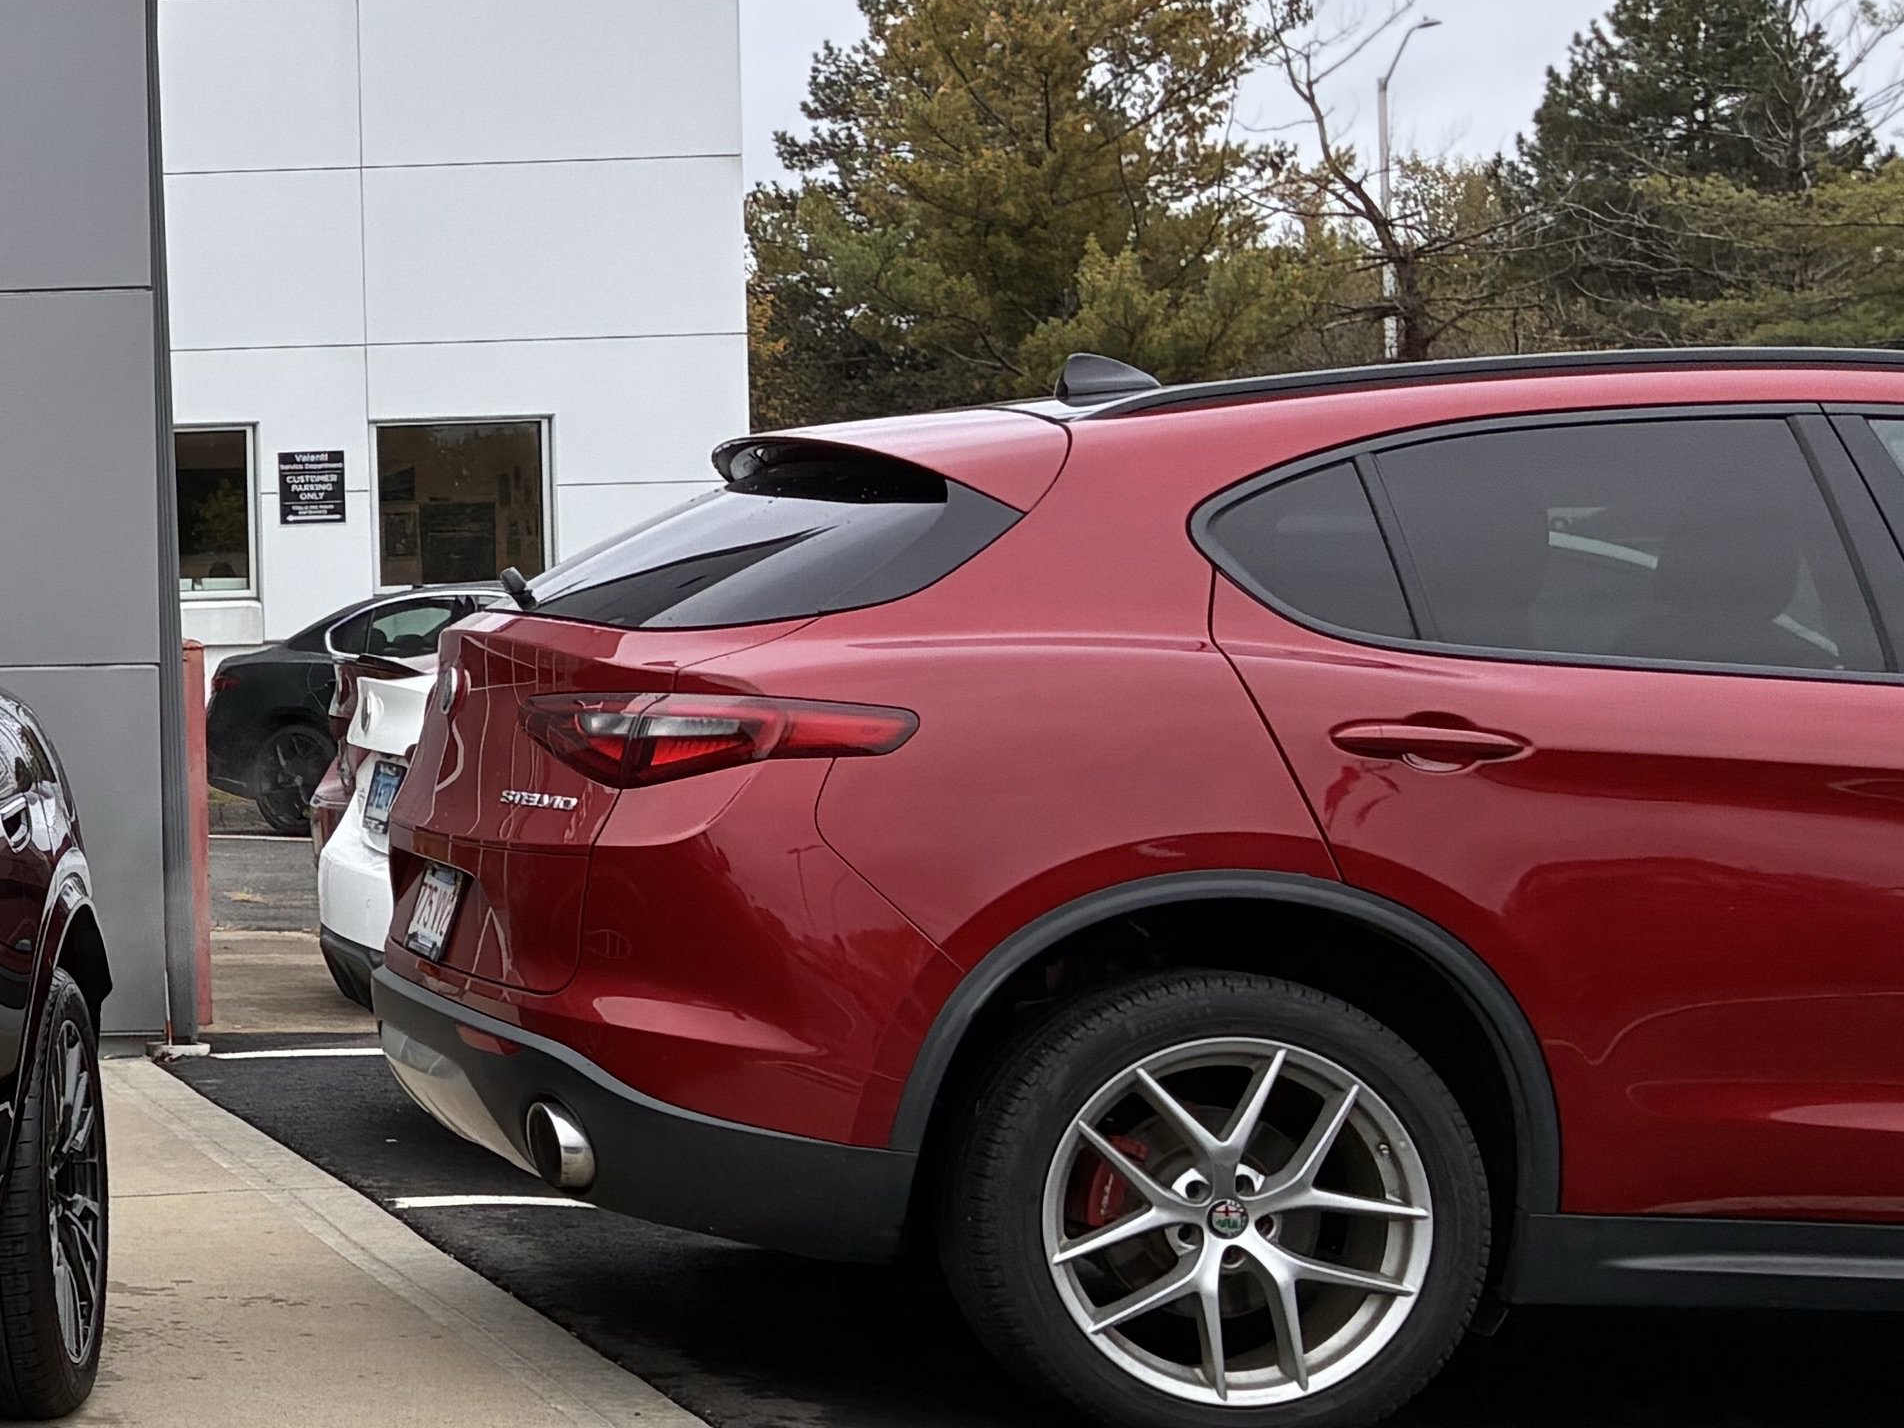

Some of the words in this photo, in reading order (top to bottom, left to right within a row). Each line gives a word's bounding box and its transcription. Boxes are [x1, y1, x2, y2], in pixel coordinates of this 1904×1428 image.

[286, 474, 338, 484] CUSTOMER
[291, 483, 333, 492] PARKING
[299, 492, 325, 500] ONLY
[500, 790, 578, 811] STELVIO
